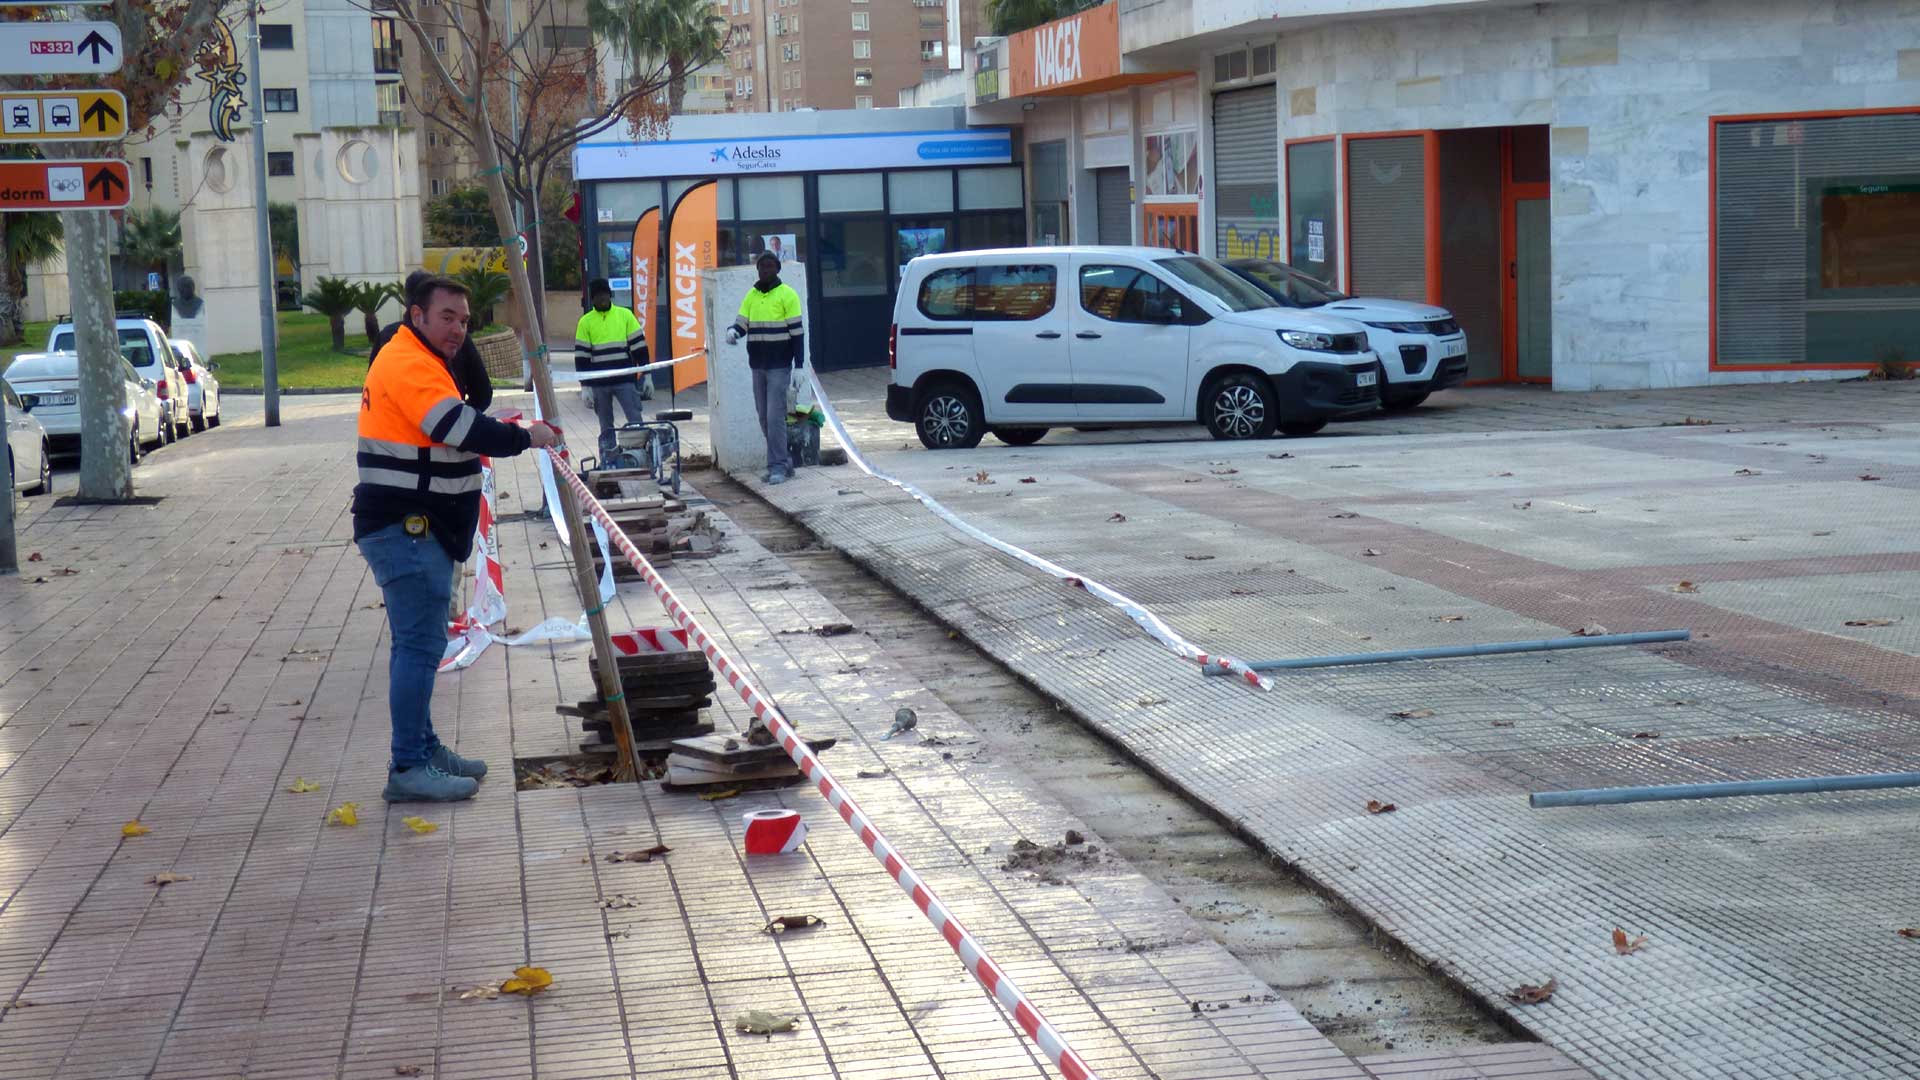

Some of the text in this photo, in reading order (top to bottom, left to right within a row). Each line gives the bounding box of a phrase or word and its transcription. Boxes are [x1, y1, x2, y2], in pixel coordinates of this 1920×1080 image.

[31, 42, 72, 53] N-332
[1035, 17, 1082, 88] NACEX
[733, 145, 781, 159] Adeslas
[0, 188, 45, 200] dorm
[675, 241, 697, 339] NACEX
